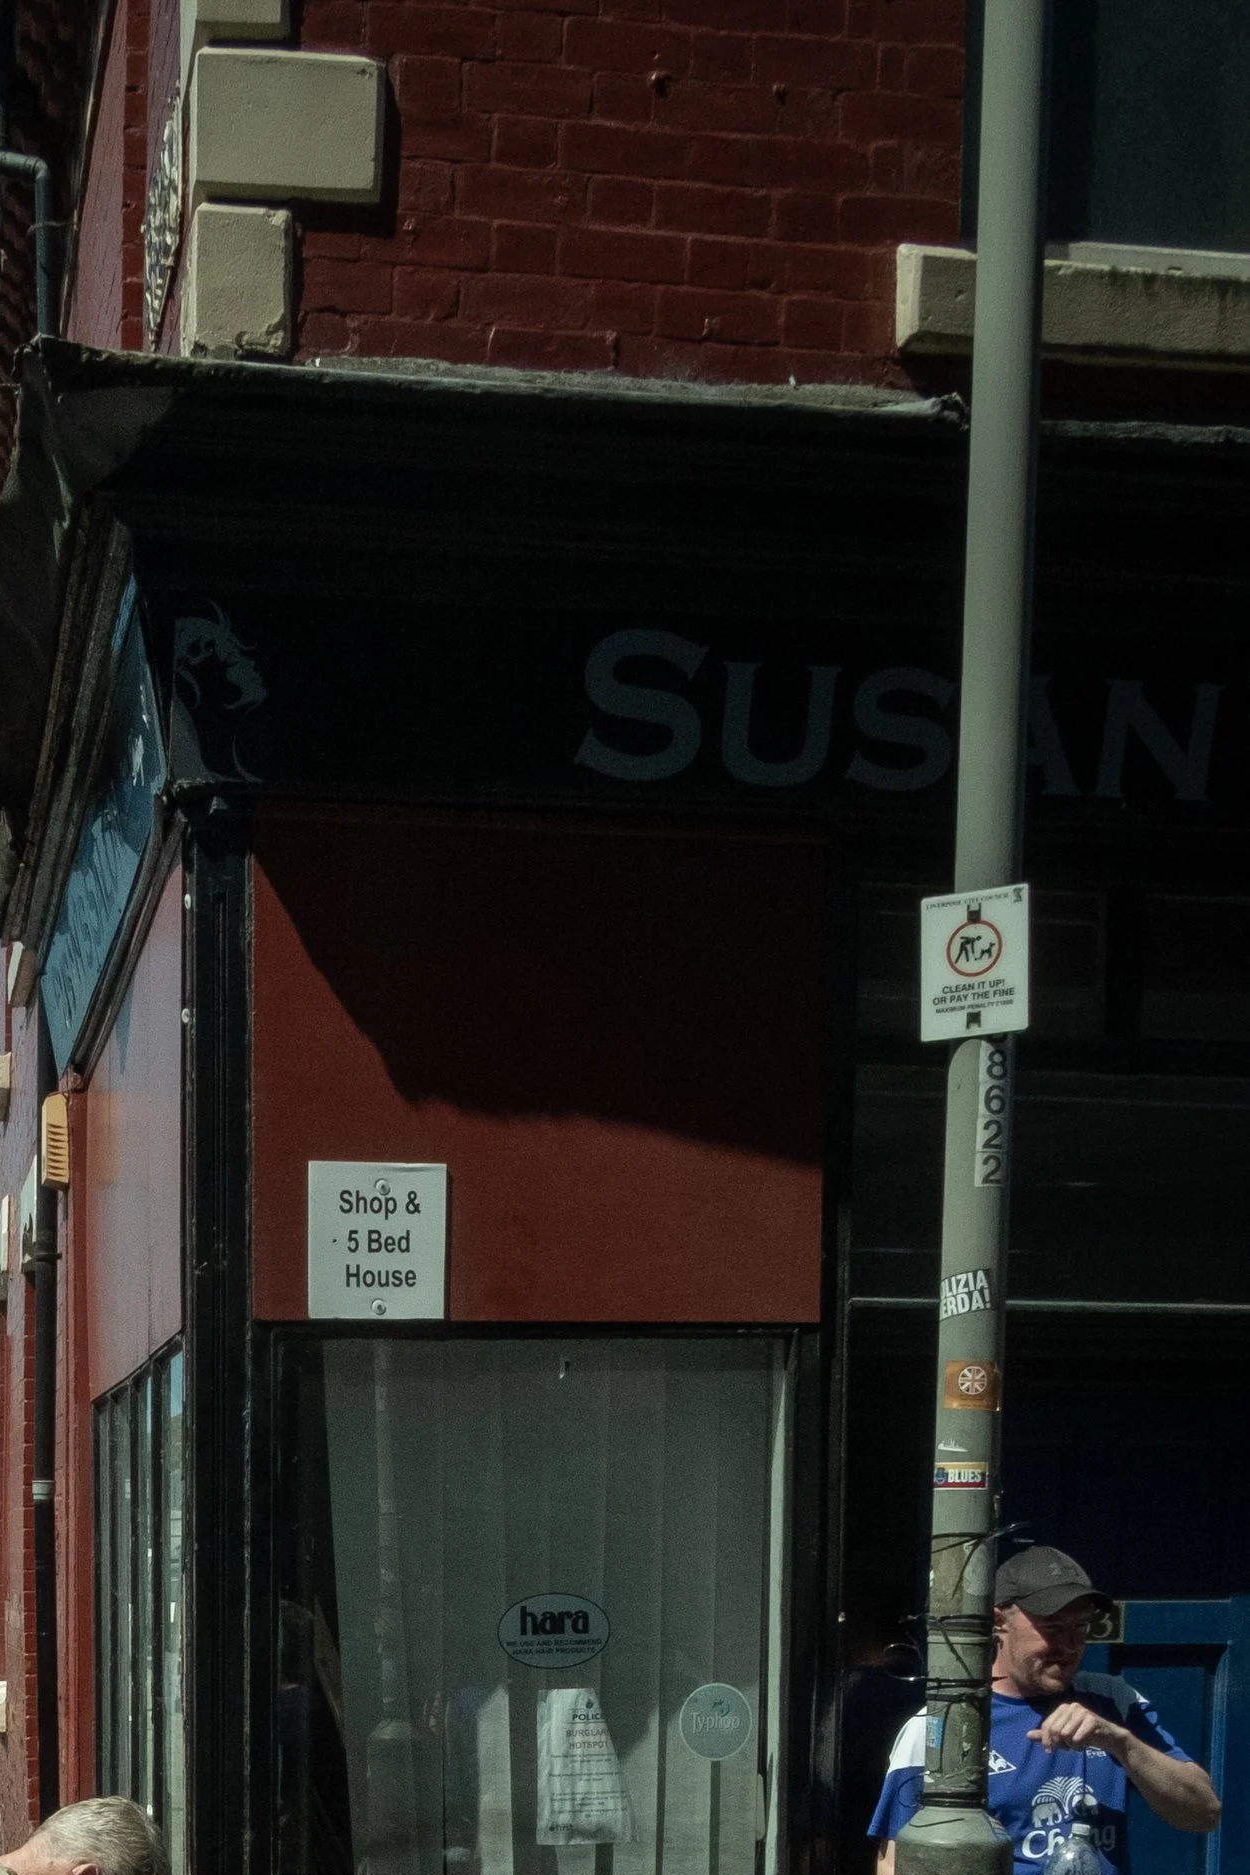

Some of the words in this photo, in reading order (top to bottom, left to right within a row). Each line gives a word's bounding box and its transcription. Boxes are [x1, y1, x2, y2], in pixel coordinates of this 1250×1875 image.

[932, 997, 947, 1006] OR
[949, 993, 970, 1004] PAY
[972, 991, 991, 1000] THE
[993, 988, 1016, 998] FINE
[942, 983, 975, 995] CLEAN
[977, 981, 986, 990] IT
[989, 979, 1006, 988] UP!
[981, 1036, 1008, 1185] 8622
[339, 1189, 398, 1220] Shop
[405, 1190, 421, 1214] &
[347, 1230, 360, 1253] 5
[367, 1230, 411, 1253] Bed
[345, 1264, 417, 1287] House
[940, 1269, 990, 1300] OLIZIA
[940, 1288, 992, 1321] ERDA!
[947, 1467, 983, 1484] BLUES
[519, 1605, 590, 1636] hara
[1022, 1826, 1116, 1859] Chng
